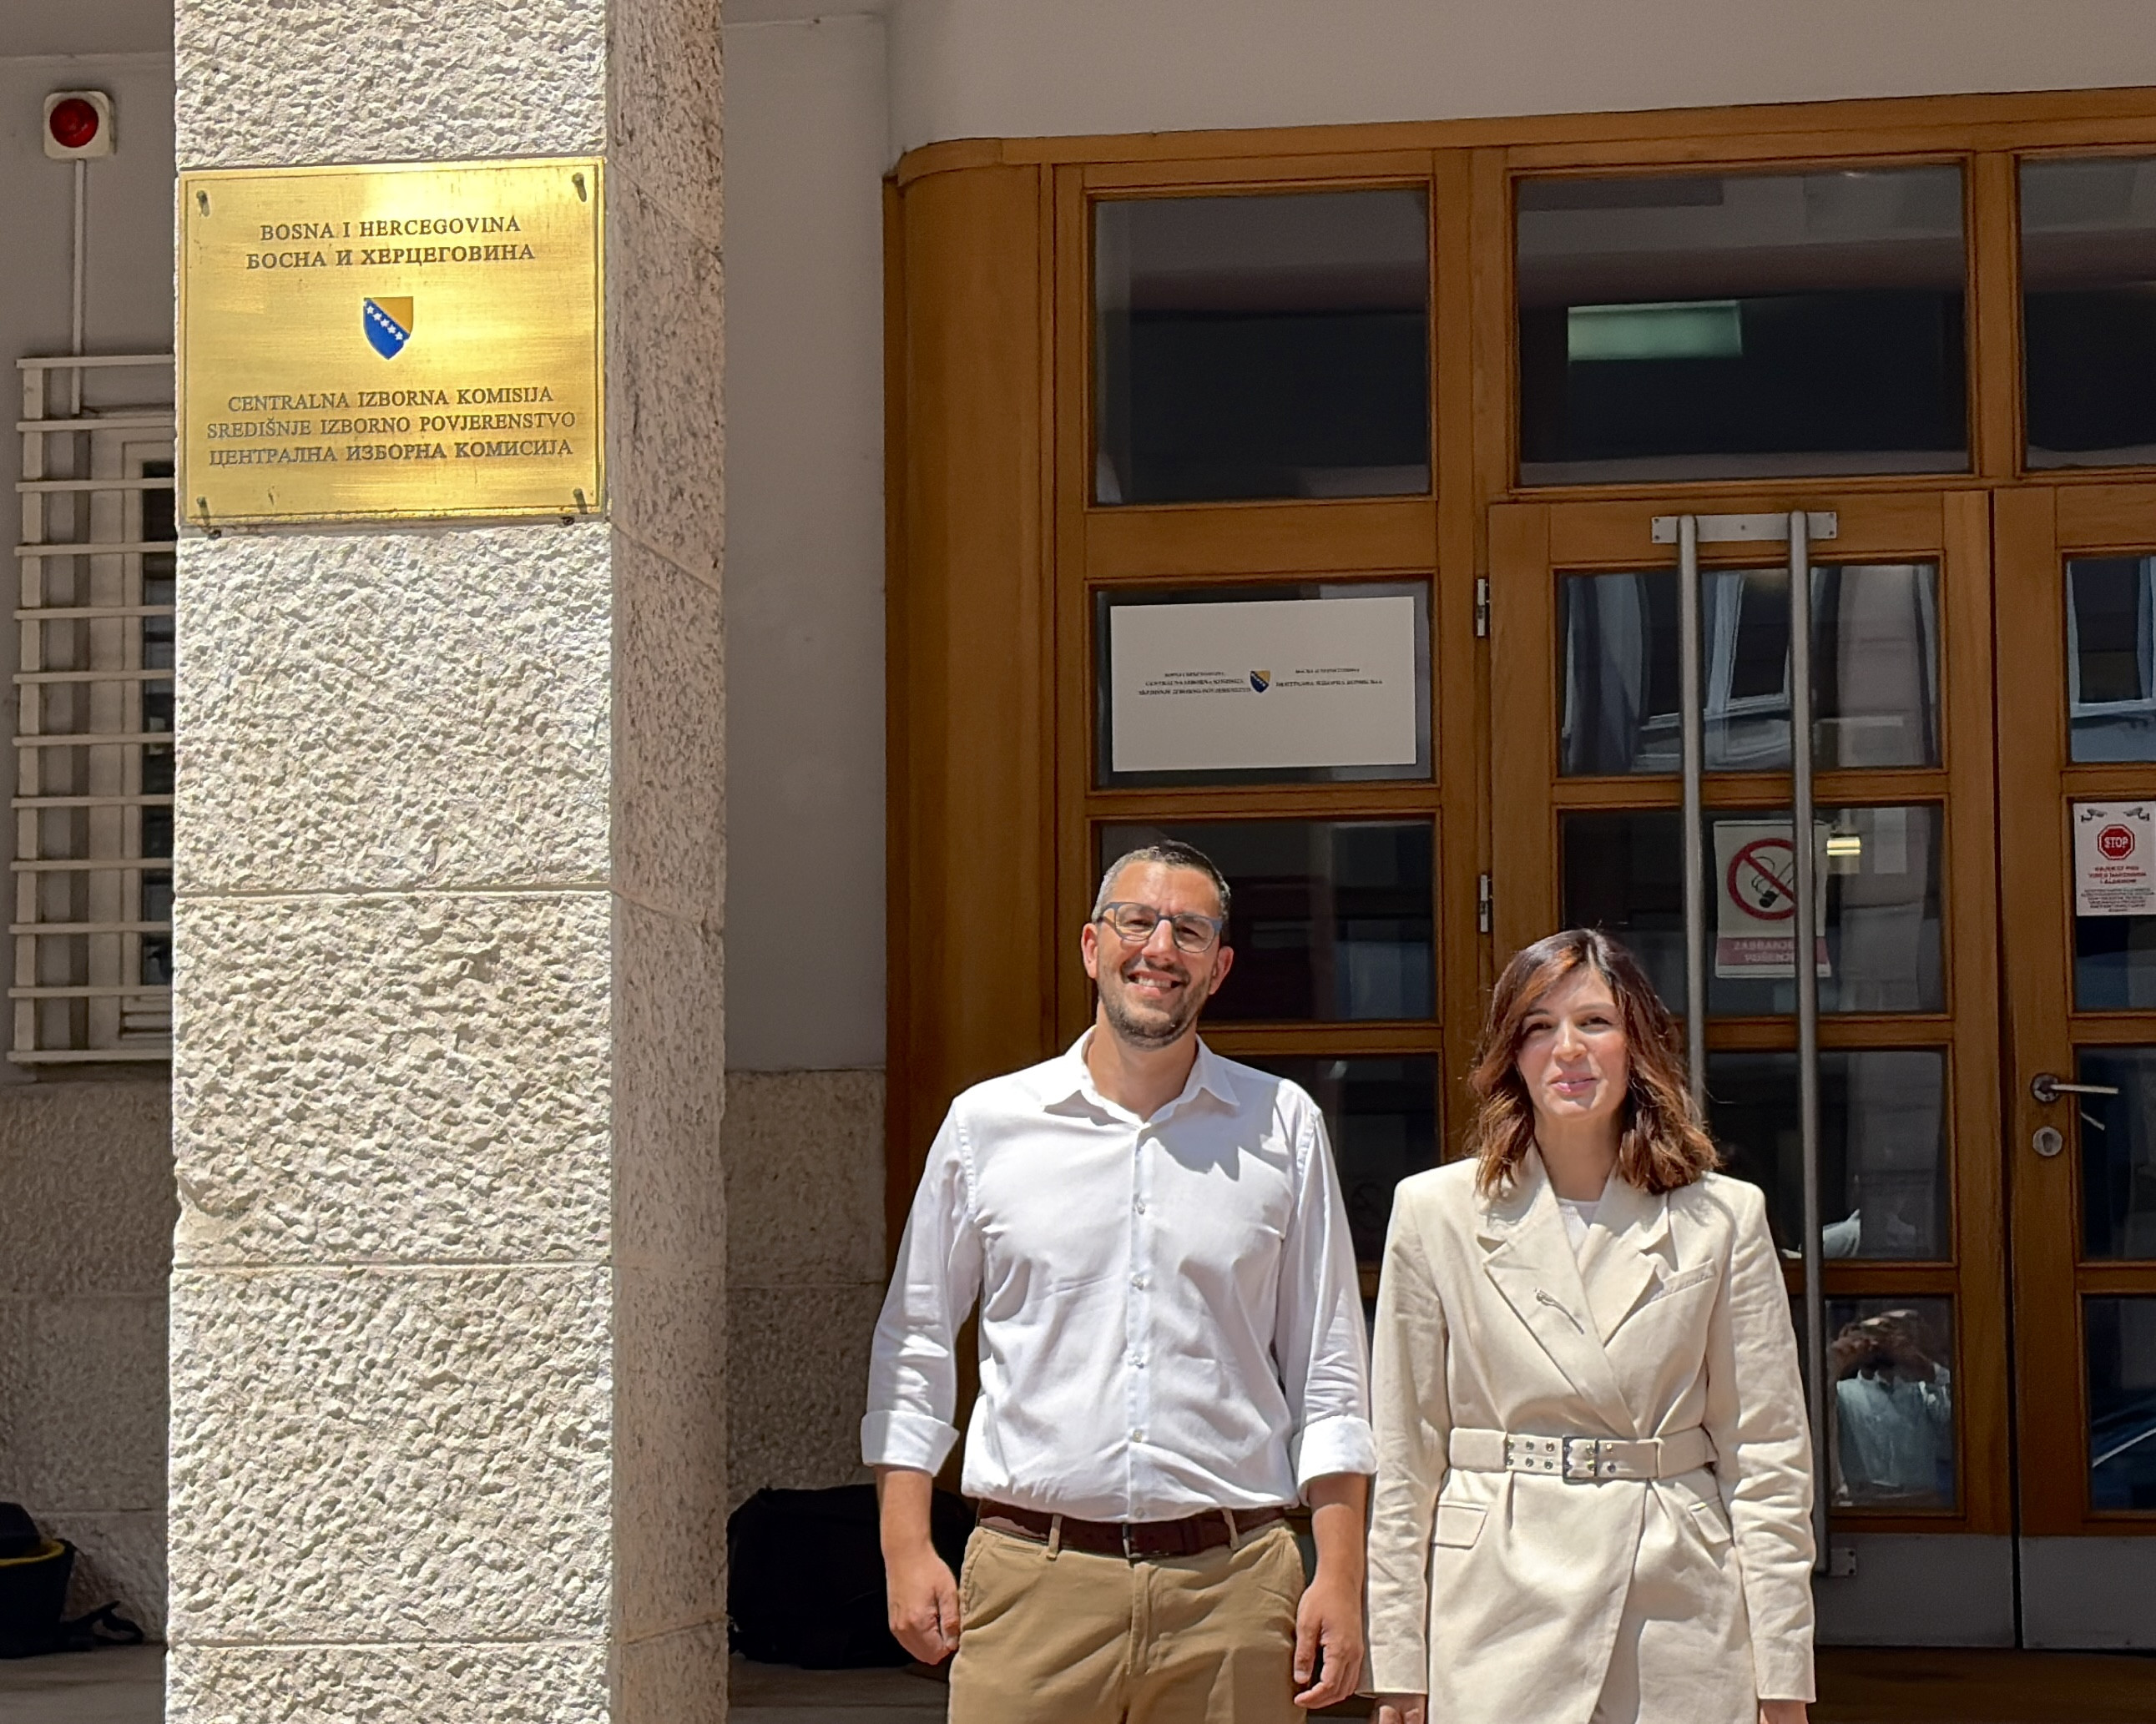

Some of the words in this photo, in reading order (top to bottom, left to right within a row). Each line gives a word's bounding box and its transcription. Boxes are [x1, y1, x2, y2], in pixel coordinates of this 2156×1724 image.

[260, 223, 334, 241] BOSNA
[343, 221, 351, 238] I
[359, 215, 521, 237] HERCEGOVINA
[245, 250, 327, 270] БОСНА
[336, 250, 352, 265] И
[361, 244, 535, 268] ХЕРЦЕГОВИНА
[228, 392, 349, 412] CENTRALNA
[357, 391, 449, 407] IZBORNA
[457, 386, 553, 405] KOMISIJA
[207, 415, 311, 438] SREDIŠNJE
[321, 416, 411, 435] IZBORNO
[420, 411, 576, 432] POVJERENSTVO
[209, 446, 337, 468] ЦЕНТРАЛНА
[346, 444, 447, 461] ИЗБОРНА
[455, 440, 573, 458] КОМИСИЈА
[2104, 836, 2128, 848] STOP
